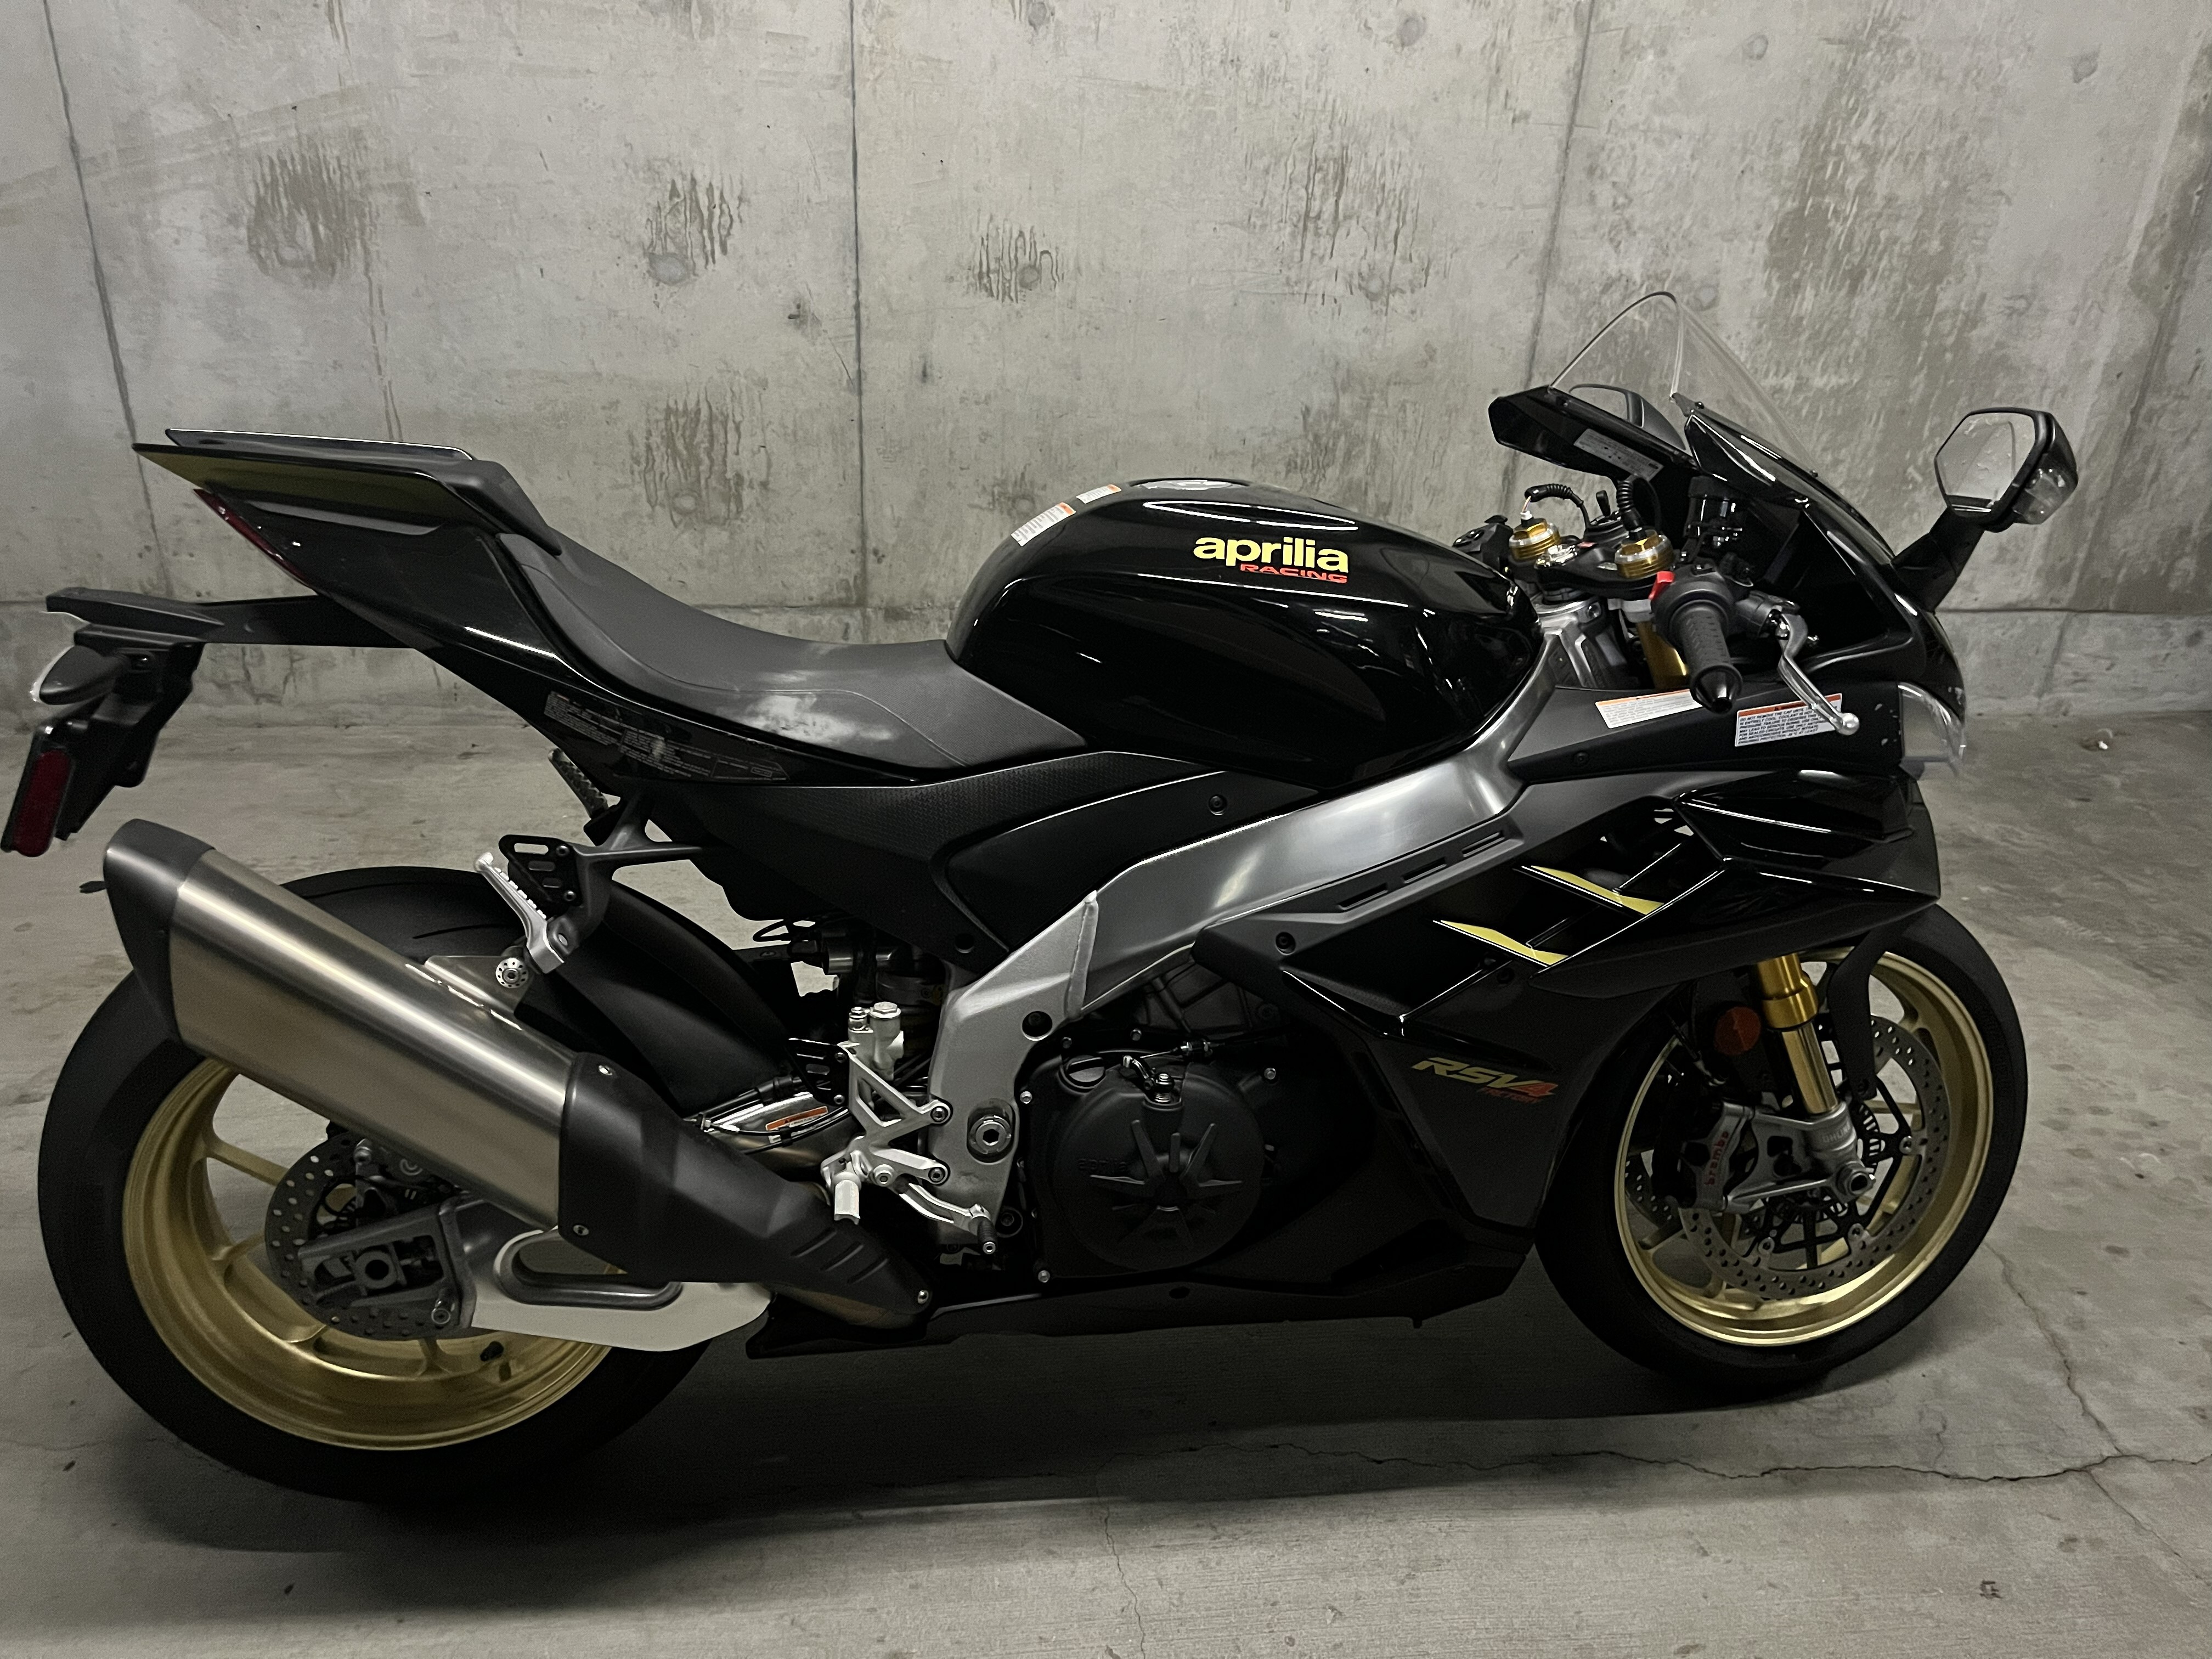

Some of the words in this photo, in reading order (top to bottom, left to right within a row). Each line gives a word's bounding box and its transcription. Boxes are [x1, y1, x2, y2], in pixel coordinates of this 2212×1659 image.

[1193, 537, 1348, 573] aprilia
[1240, 563, 1347, 584] RACING
[1703, 1131, 1729, 1186] brembo
